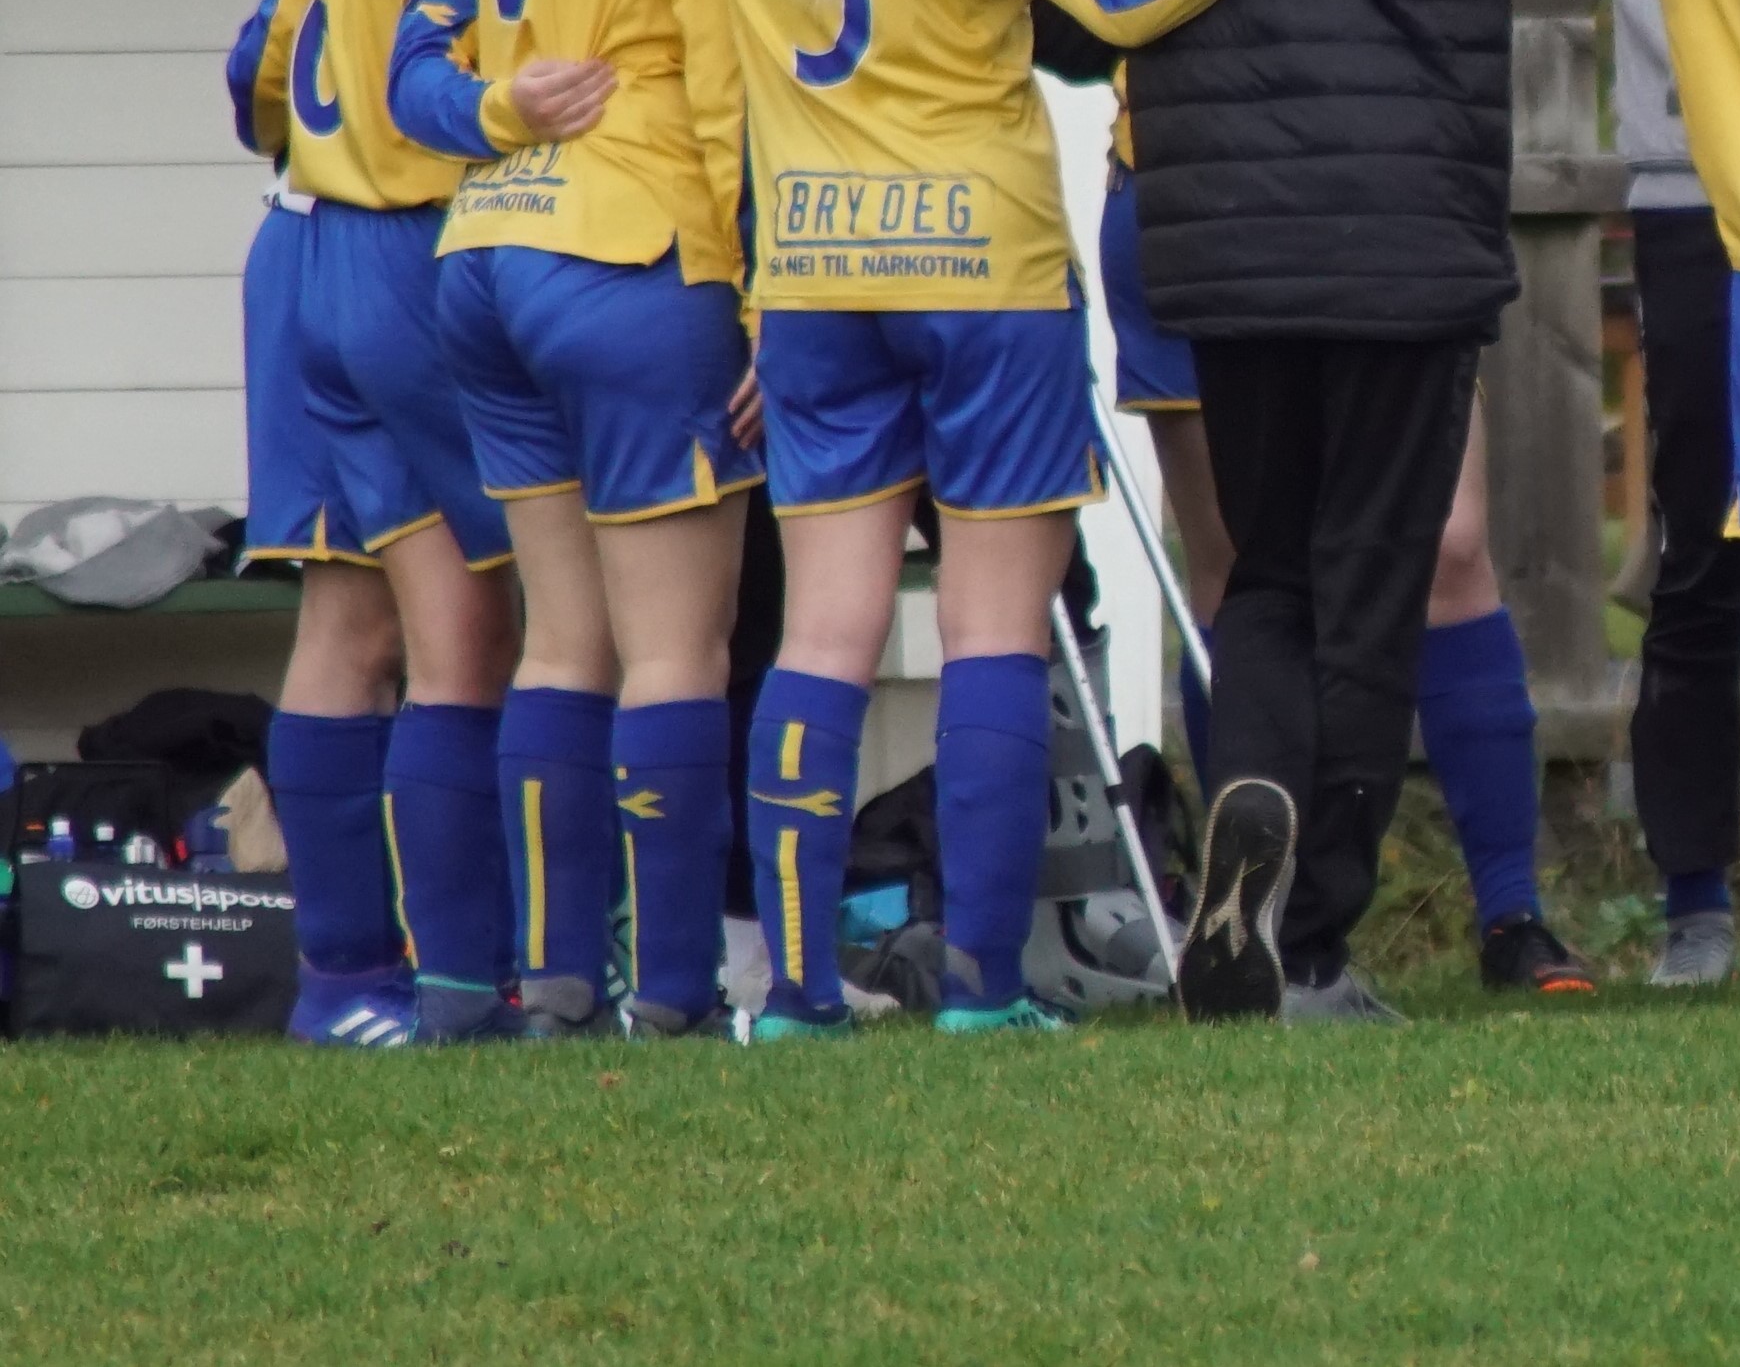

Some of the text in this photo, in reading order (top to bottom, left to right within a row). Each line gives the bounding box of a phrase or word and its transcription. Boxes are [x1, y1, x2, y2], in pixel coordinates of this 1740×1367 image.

[787, 181, 972, 235] BRY DEG
[786, 255, 815, 277] NEI
[822, 255, 854, 277] TIL
[861, 255, 990, 279] NARKOTIKA
[133, 916, 254, 932] FØRSTEHJELP
